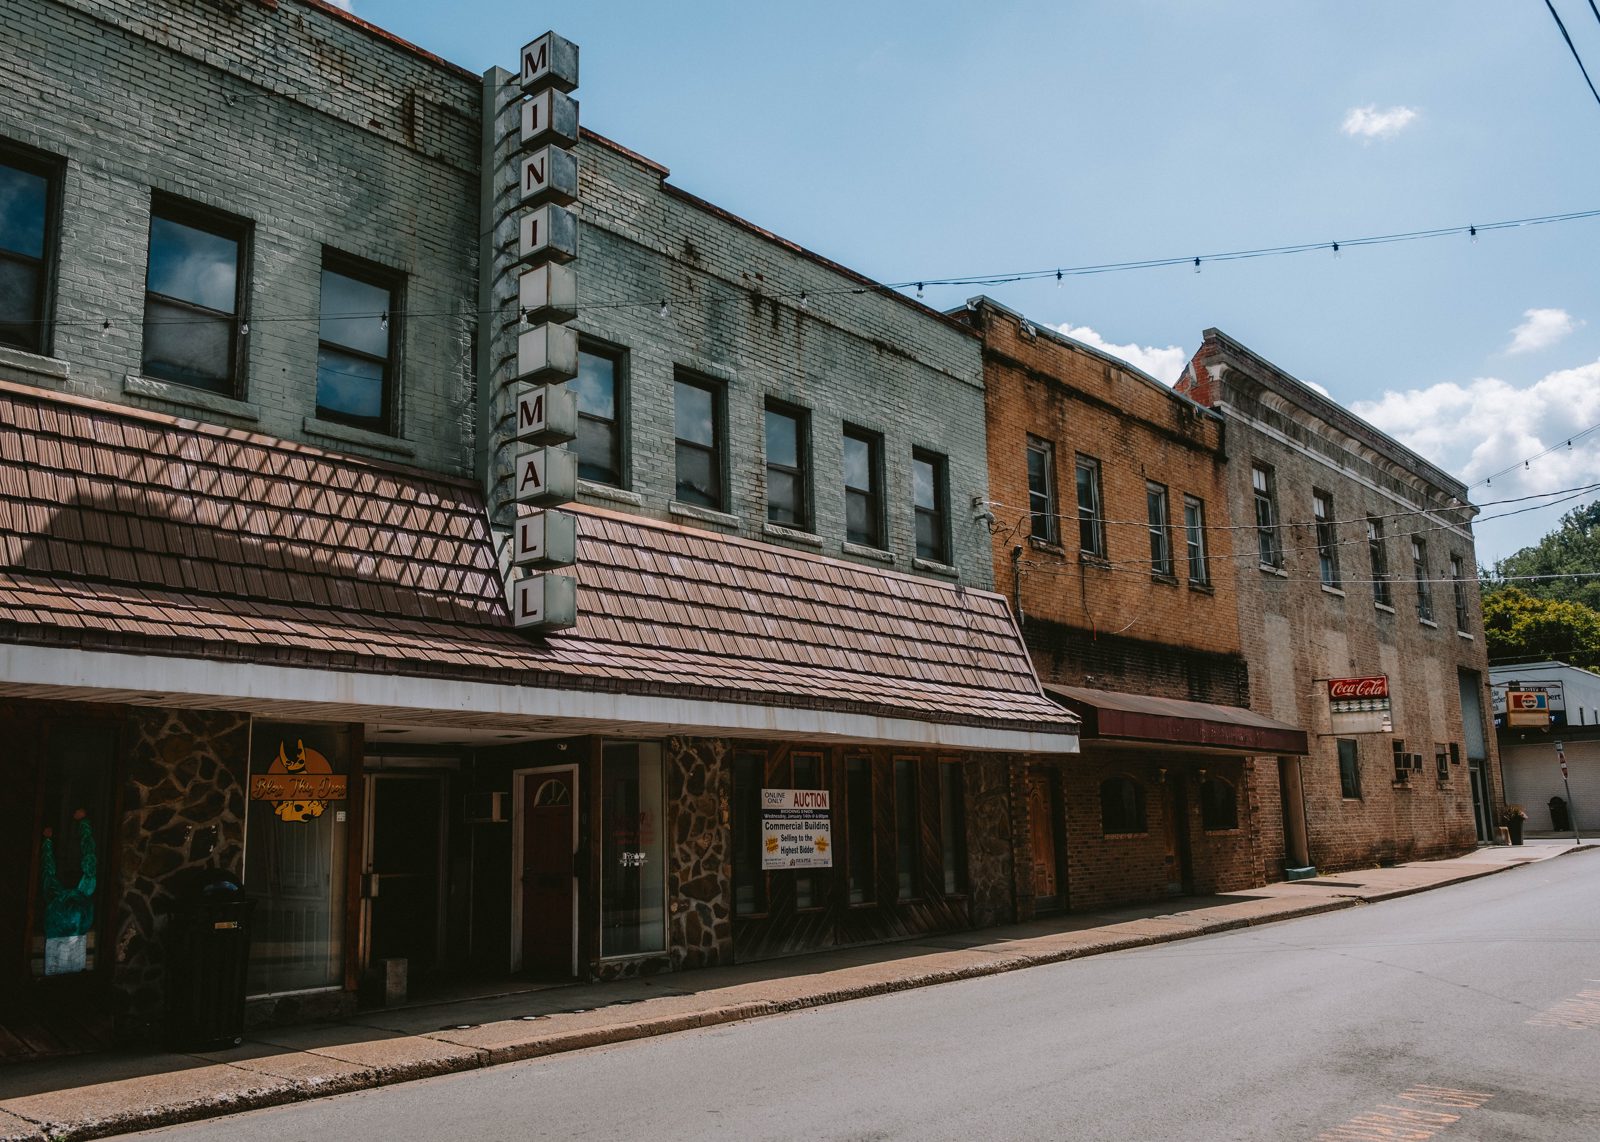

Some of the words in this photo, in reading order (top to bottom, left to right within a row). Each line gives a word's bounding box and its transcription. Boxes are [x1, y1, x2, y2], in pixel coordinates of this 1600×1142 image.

[524, 43, 547, 247] MINI
[520, 394, 543, 617] MALL
[1331, 680, 1383, 697] Coca-Cola
[794, 792, 827, 807] AUCTION
[765, 821, 803, 830] Commercial
[805, 822, 829, 831] Building
[780, 834, 798, 843] Selling
[780, 846, 798, 856] Highest
[800, 846, 814, 854] Bidder
